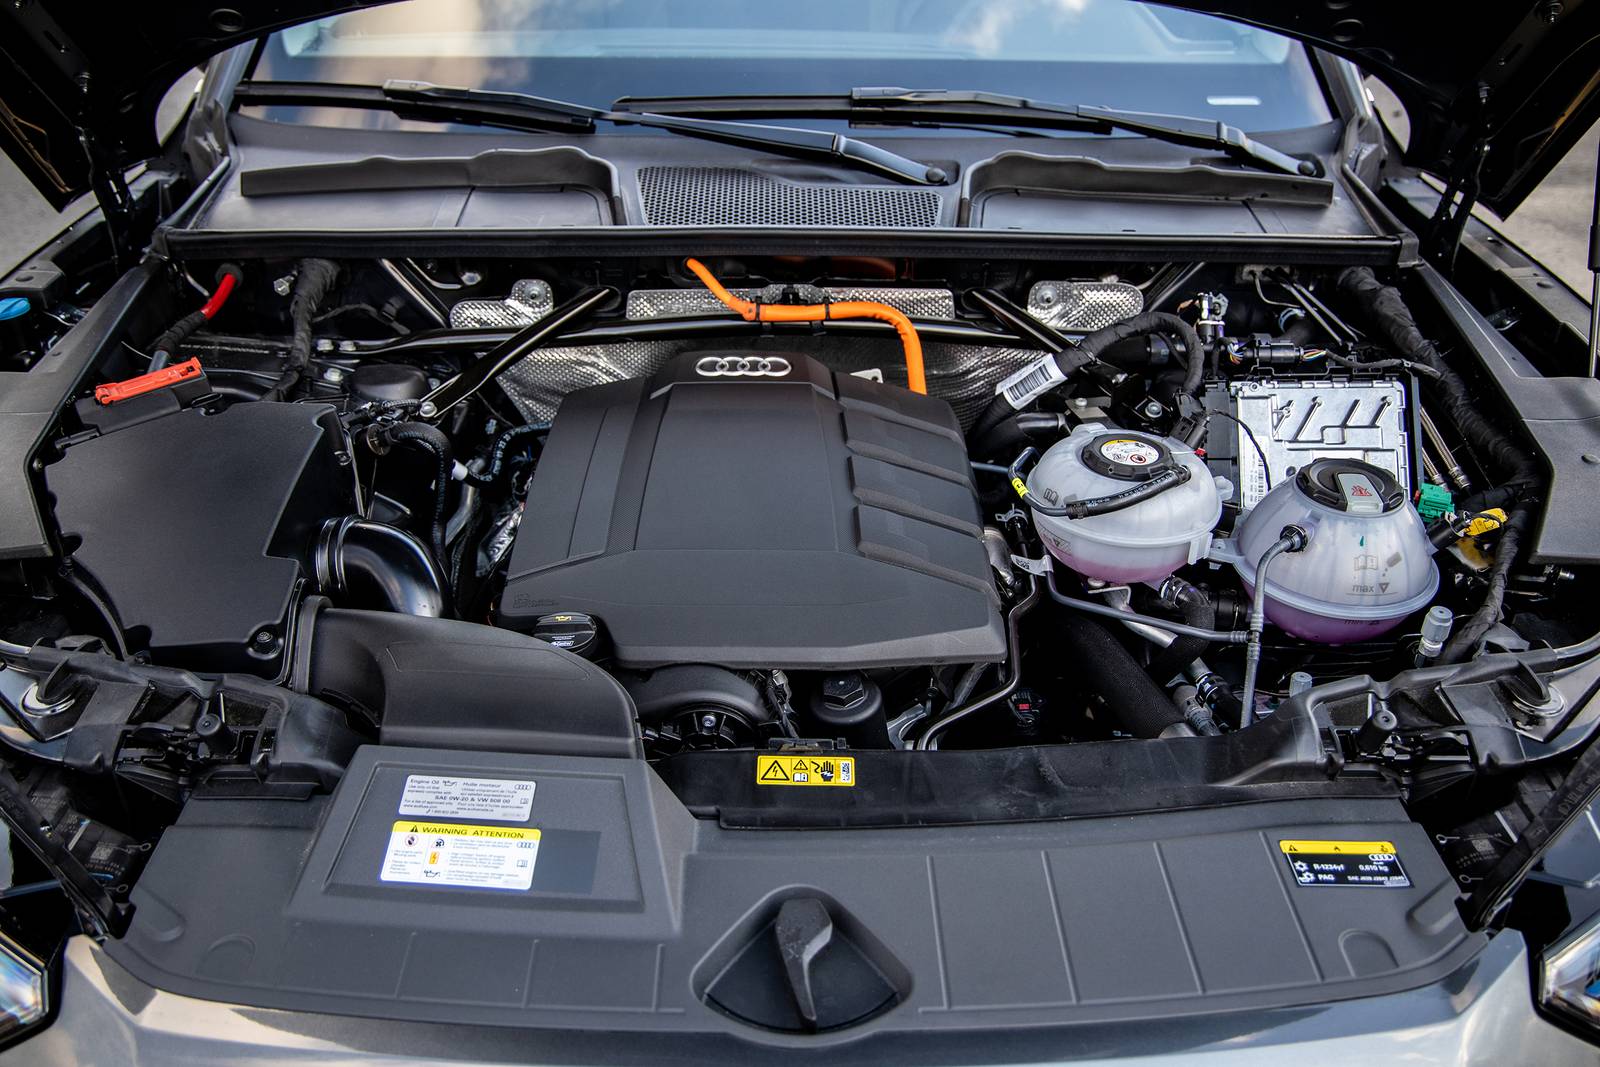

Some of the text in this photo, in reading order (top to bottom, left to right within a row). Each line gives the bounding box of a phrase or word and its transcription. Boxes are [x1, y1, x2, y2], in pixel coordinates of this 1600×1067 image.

[1352, 584, 1374, 593] max
[422, 827, 524, 839] WARNING ATTENTION
[1318, 873, 1335, 881] PAG
